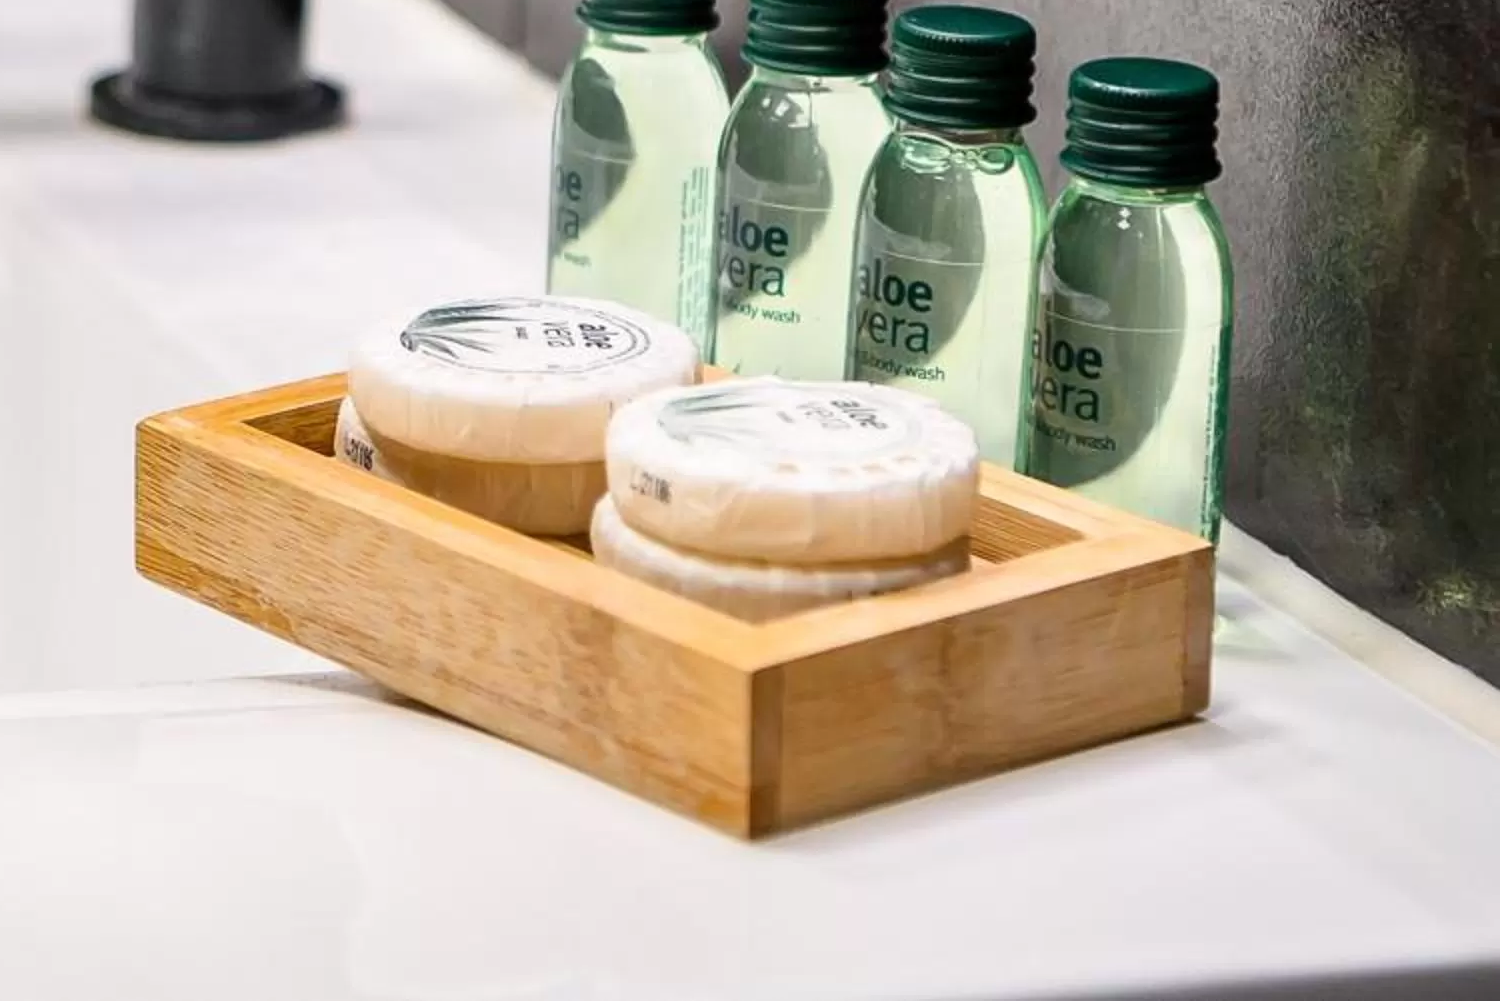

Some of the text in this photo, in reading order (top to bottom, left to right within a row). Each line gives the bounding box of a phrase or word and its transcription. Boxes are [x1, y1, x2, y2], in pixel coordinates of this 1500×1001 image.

[718, 205, 789, 258] aloe
[858, 258, 934, 313] aloe
[761, 308, 802, 324] wash
[905, 366, 946, 382] wash
[1030, 317, 1103, 381] aloe
